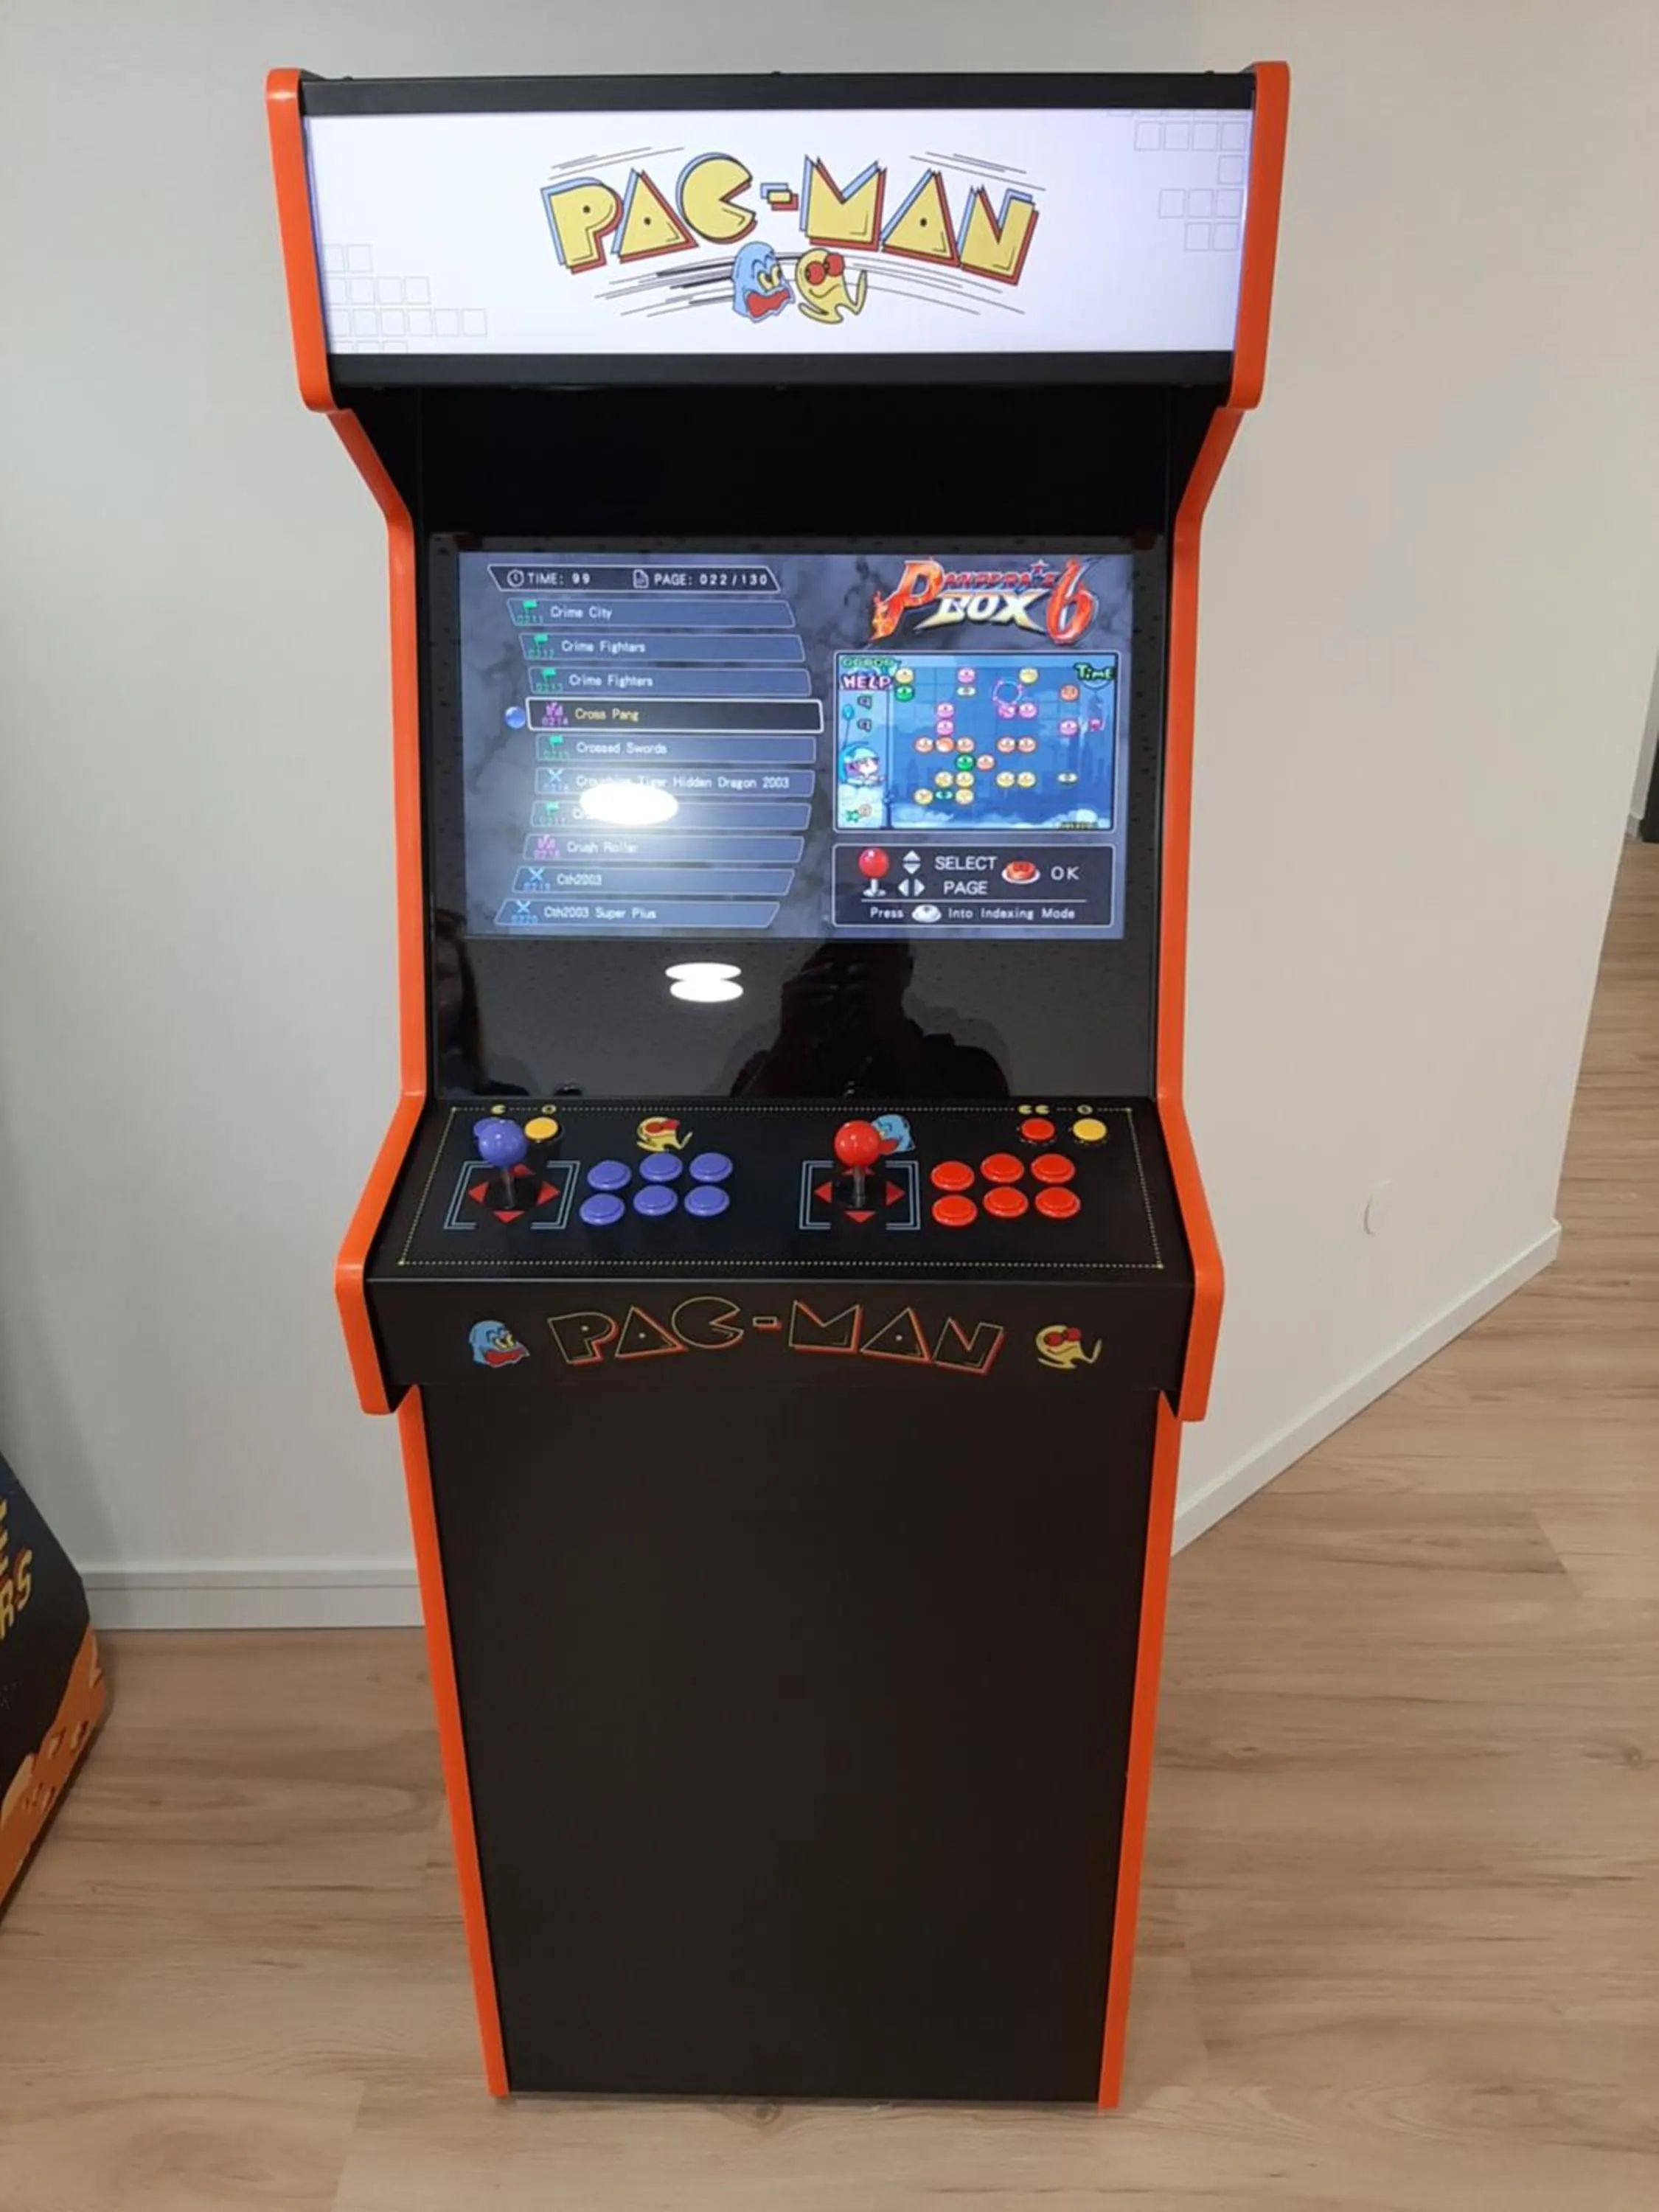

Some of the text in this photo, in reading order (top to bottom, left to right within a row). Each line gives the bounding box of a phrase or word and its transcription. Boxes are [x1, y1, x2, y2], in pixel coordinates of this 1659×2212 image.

[540, 151, 1040, 286] PAC-MAN
[529, 572, 591, 585] TIME: 99
[654, 573, 768, 585] PAGE: 022/130
[914, 556, 1100, 646] BOX 6
[550, 605, 613, 621] Crime City
[561, 640, 646, 654] Crime Fighters
[569, 674, 653, 689] Crime Fighters
[843, 675, 892, 690] HELP
[575, 708, 639, 722] Cross Pang
[576, 741, 667, 754] Crossed Swords
[673, 776, 712, 788] Hidden
[718, 776, 756, 790] Dragon
[762, 776, 790, 789] 2003
[567, 841, 598, 853] Crush
[934, 856, 998, 871] SELECT
[1051, 866, 1079, 881] OK
[944, 880, 988, 895] PAGE
[596, 907, 626, 920] Super
[632, 908, 656, 919] Plus
[870, 907, 1077, 921] Press Into Indexing Mode
[547, 1296, 1004, 1374] PAC-MAN
